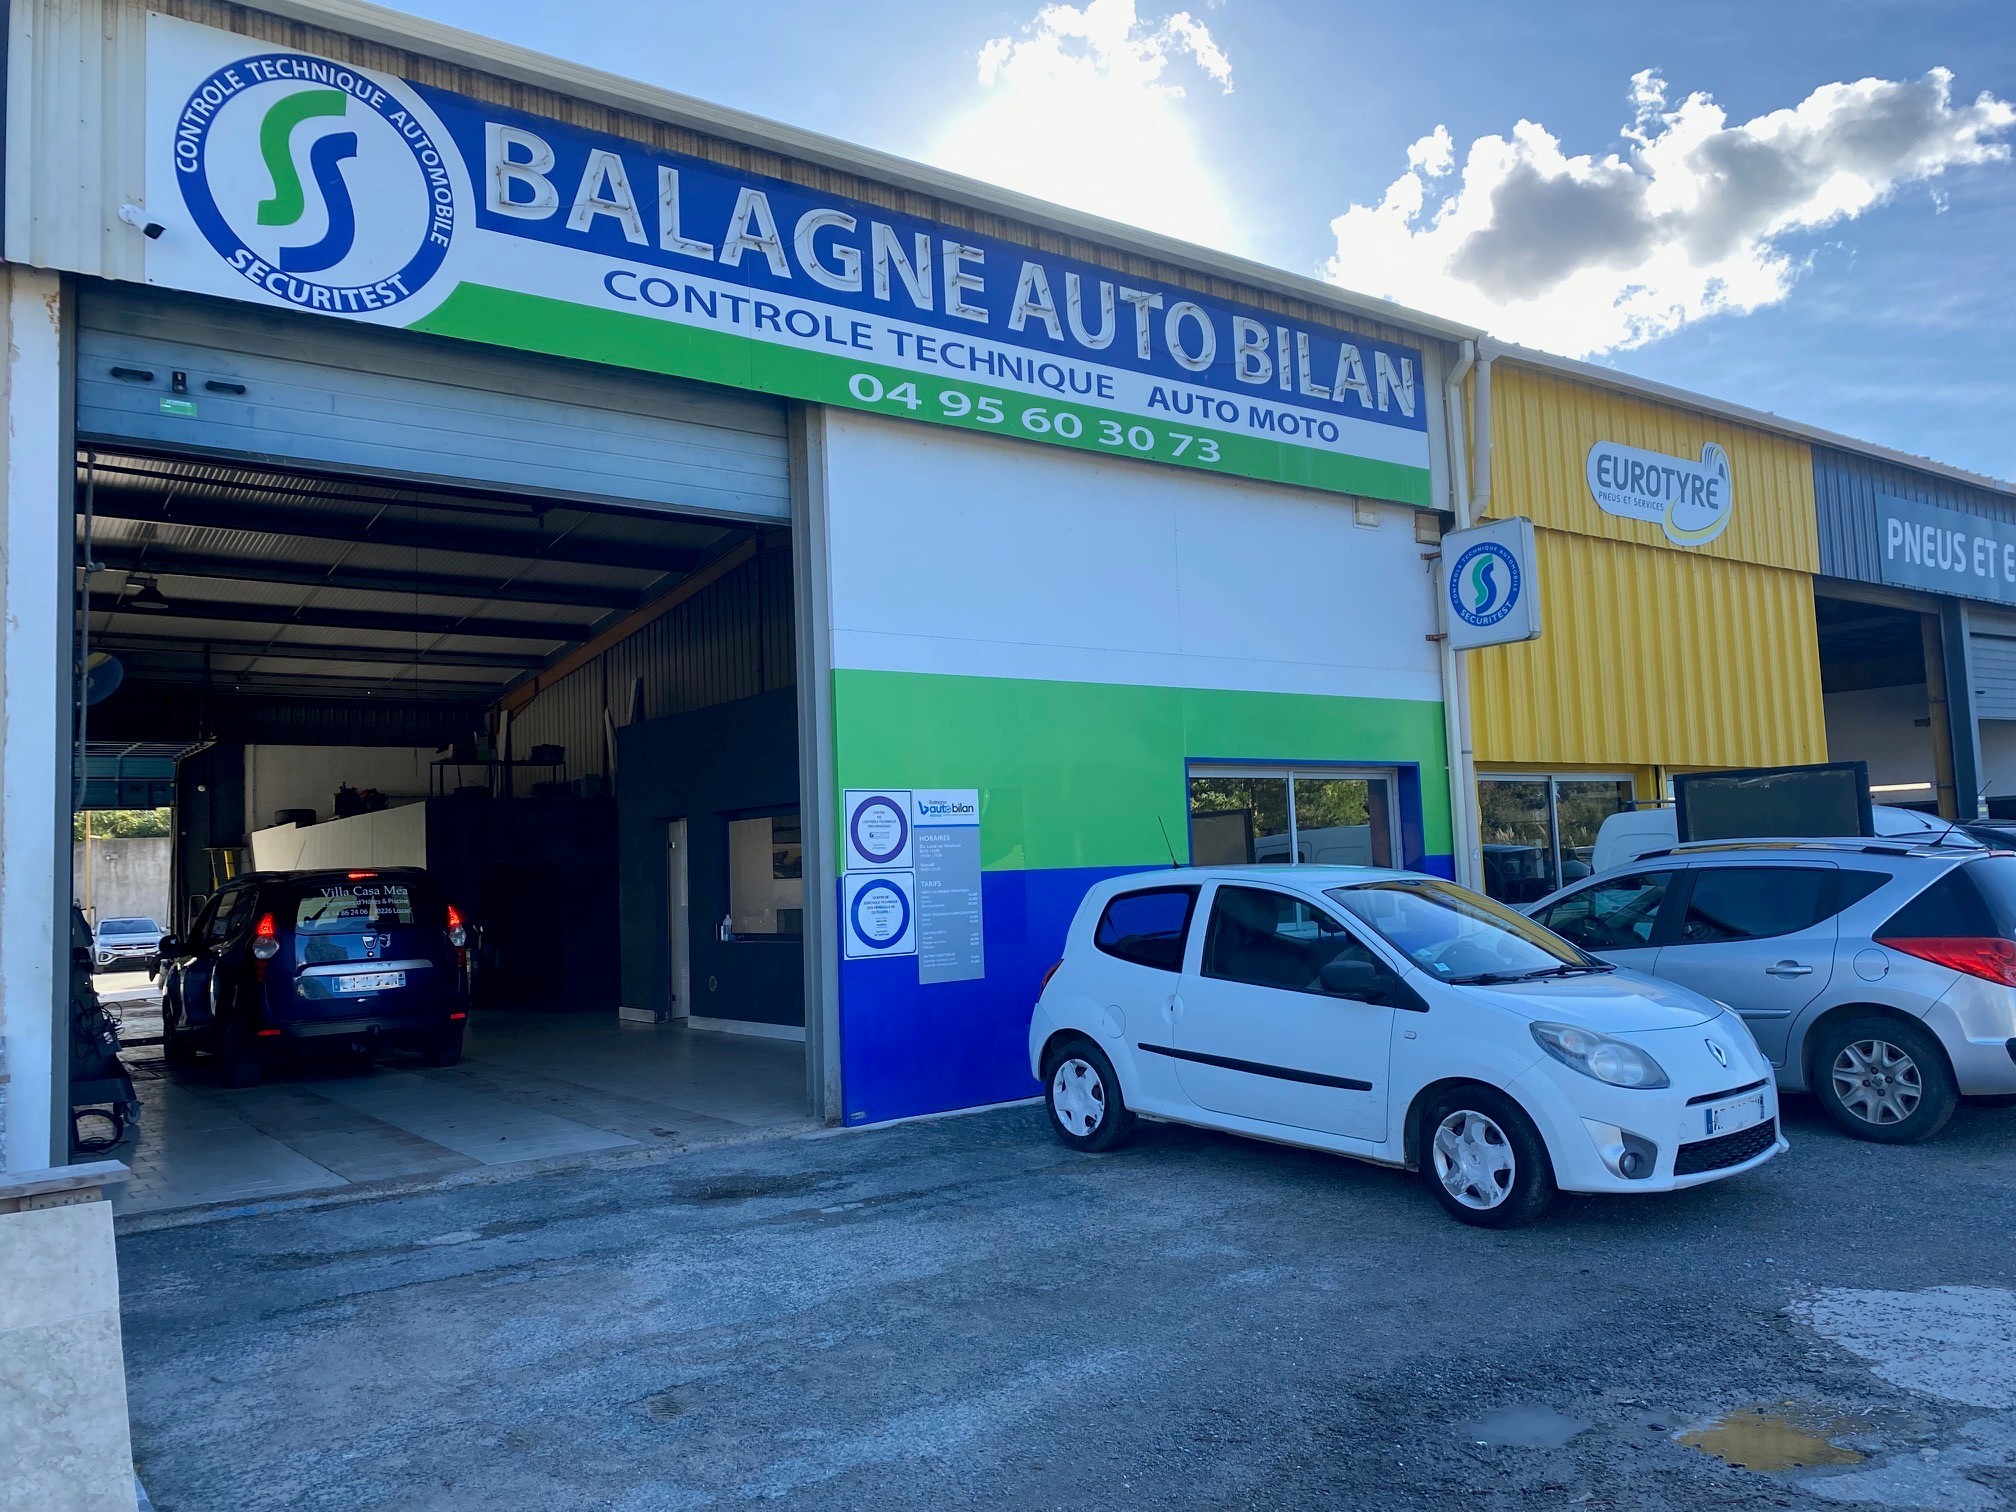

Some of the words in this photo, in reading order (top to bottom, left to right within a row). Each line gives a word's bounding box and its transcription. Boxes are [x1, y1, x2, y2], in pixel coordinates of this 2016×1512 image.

[177, 69, 246, 173] CONTROLE
[244, 58, 387, 109] TECHNIQUE
[389, 110, 453, 248] AUTOMOBILE
[226, 248, 410, 312] SECURITEST
[485, 121, 989, 325] BALAGNE
[1008, 261, 1217, 372] AUTO
[1233, 315, 1416, 419] BILAN
[604, 270, 874, 351] CONTROLE
[887, 328, 1115, 400] TECHNIQUE
[1147, 386, 1240, 424] AUTO
[1249, 407, 1340, 443] MOTO
[848, 374, 922, 410] 04
[939, 390, 1005, 424] 95
[1022, 407, 1083, 439] 60
[1099, 419, 1155, 451] 30
[1168, 432, 1221, 463] 73
[1597, 453, 1719, 510] EUROTYRE
[1598, 491, 1621, 503] PNEUS
[1623, 495, 1632, 505] ET
[1633, 497, 1664, 512] SERVICES
[1452, 564, 1462, 604] CONTROLE
[1462, 545, 1498, 563] TECHNIQUE
[1499, 549, 1518, 592] AUTOMOBILE
[1887, 517, 1967, 573] PNEUS
[1973, 536, 1998, 578] ET
[1460, 601, 1513, 625] SECURITEST
[321, 887, 349, 898] Villa
[353, 886, 380, 896] Casa
[383, 886, 408, 895] Mea
